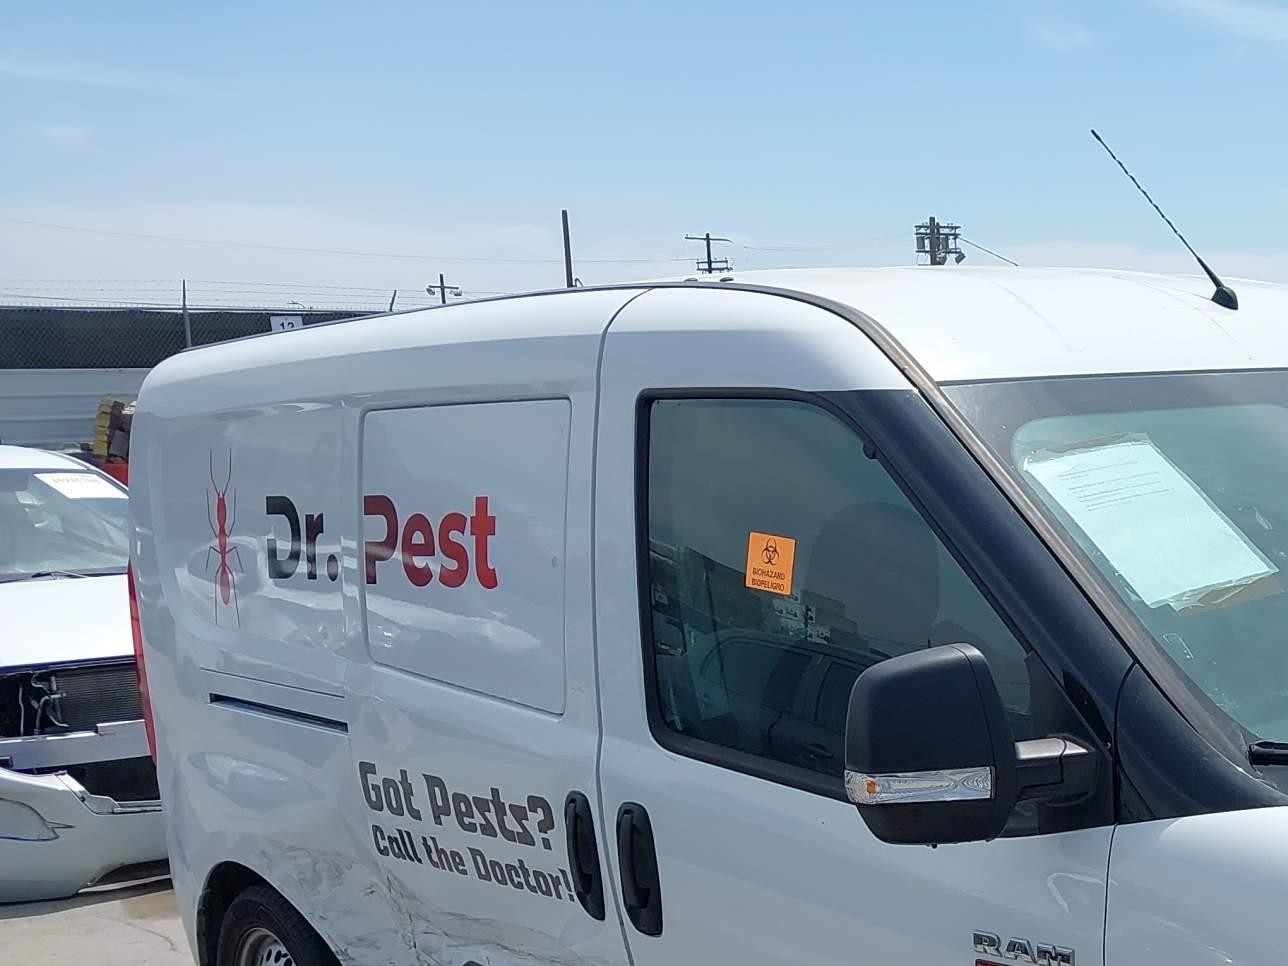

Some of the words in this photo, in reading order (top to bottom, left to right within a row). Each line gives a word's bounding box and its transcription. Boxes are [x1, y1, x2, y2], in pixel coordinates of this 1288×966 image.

[265, 495, 339, 582] Dr.
[363, 494, 499, 590] Pest
[752, 567, 786, 580] BIOHAZARD
[751, 578, 785, 592] BIOPELIGRO
[358, 761, 423, 822] Got
[421, 773, 556, 851] Pests?
[371, 824, 424, 865] Call
[421, 835, 469, 876] the
[466, 847, 576, 903] Doctor!
